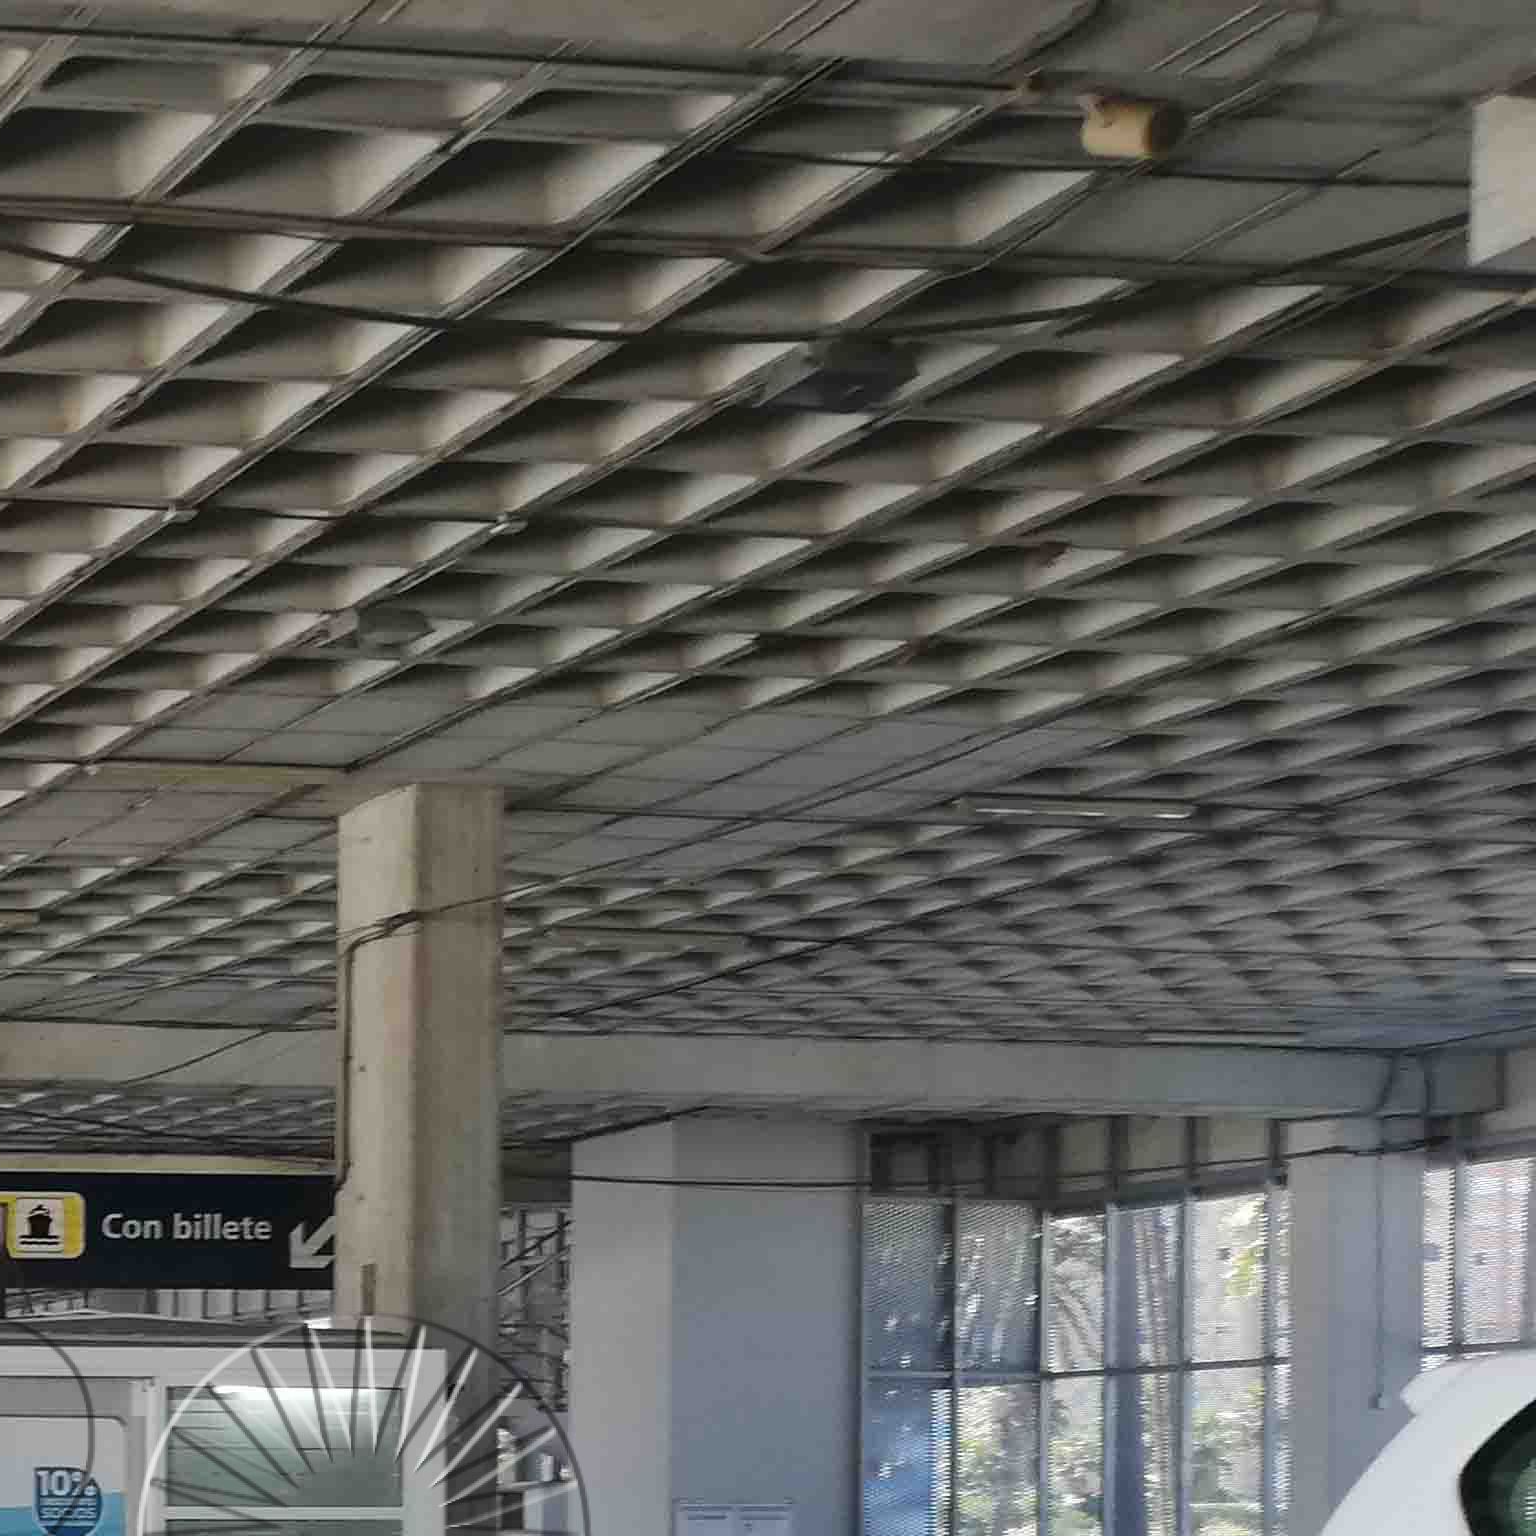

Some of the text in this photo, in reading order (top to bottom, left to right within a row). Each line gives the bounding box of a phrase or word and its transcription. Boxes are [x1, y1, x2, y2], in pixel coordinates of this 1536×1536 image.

[101, 1211, 273, 1241] Con billete
[35, 1469, 97, 1497] 10%
